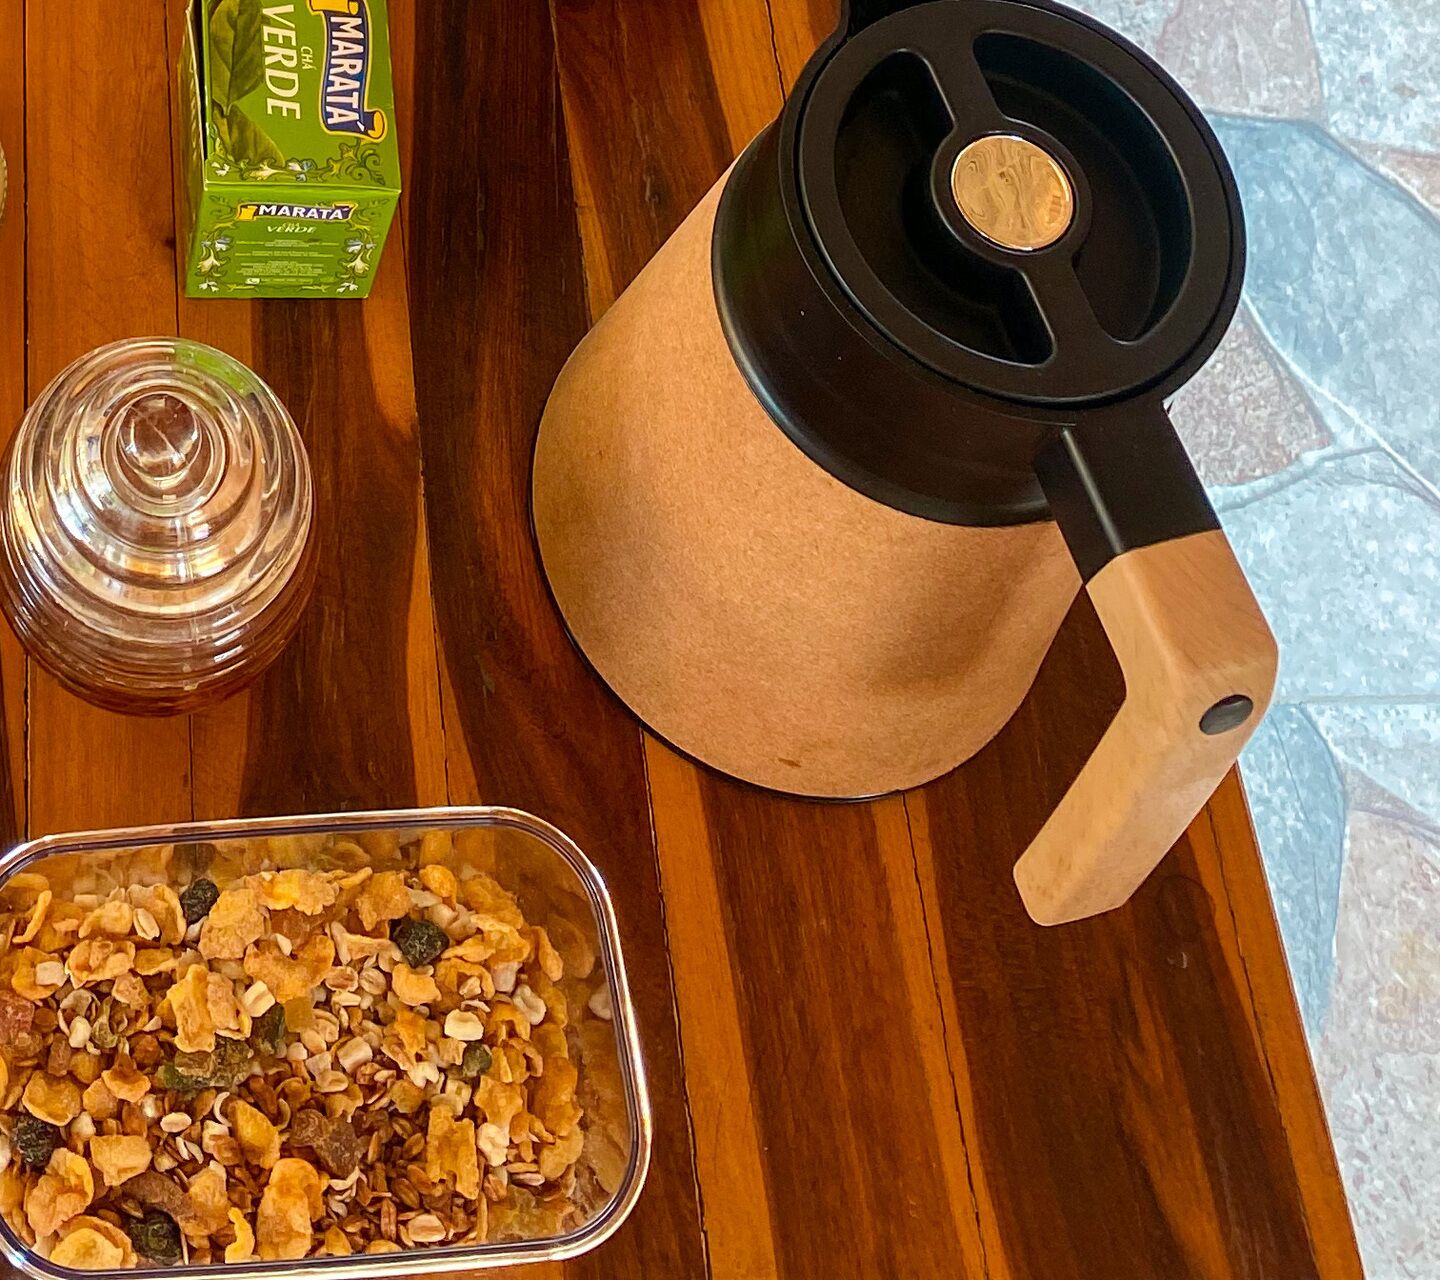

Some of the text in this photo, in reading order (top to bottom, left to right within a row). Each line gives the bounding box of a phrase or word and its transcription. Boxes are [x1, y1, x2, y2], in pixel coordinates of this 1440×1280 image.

[262, 4, 301, 120] VERDE
[324, 16, 365, 132] MARATÁ
[258, 204, 349, 221] MARATÁ
